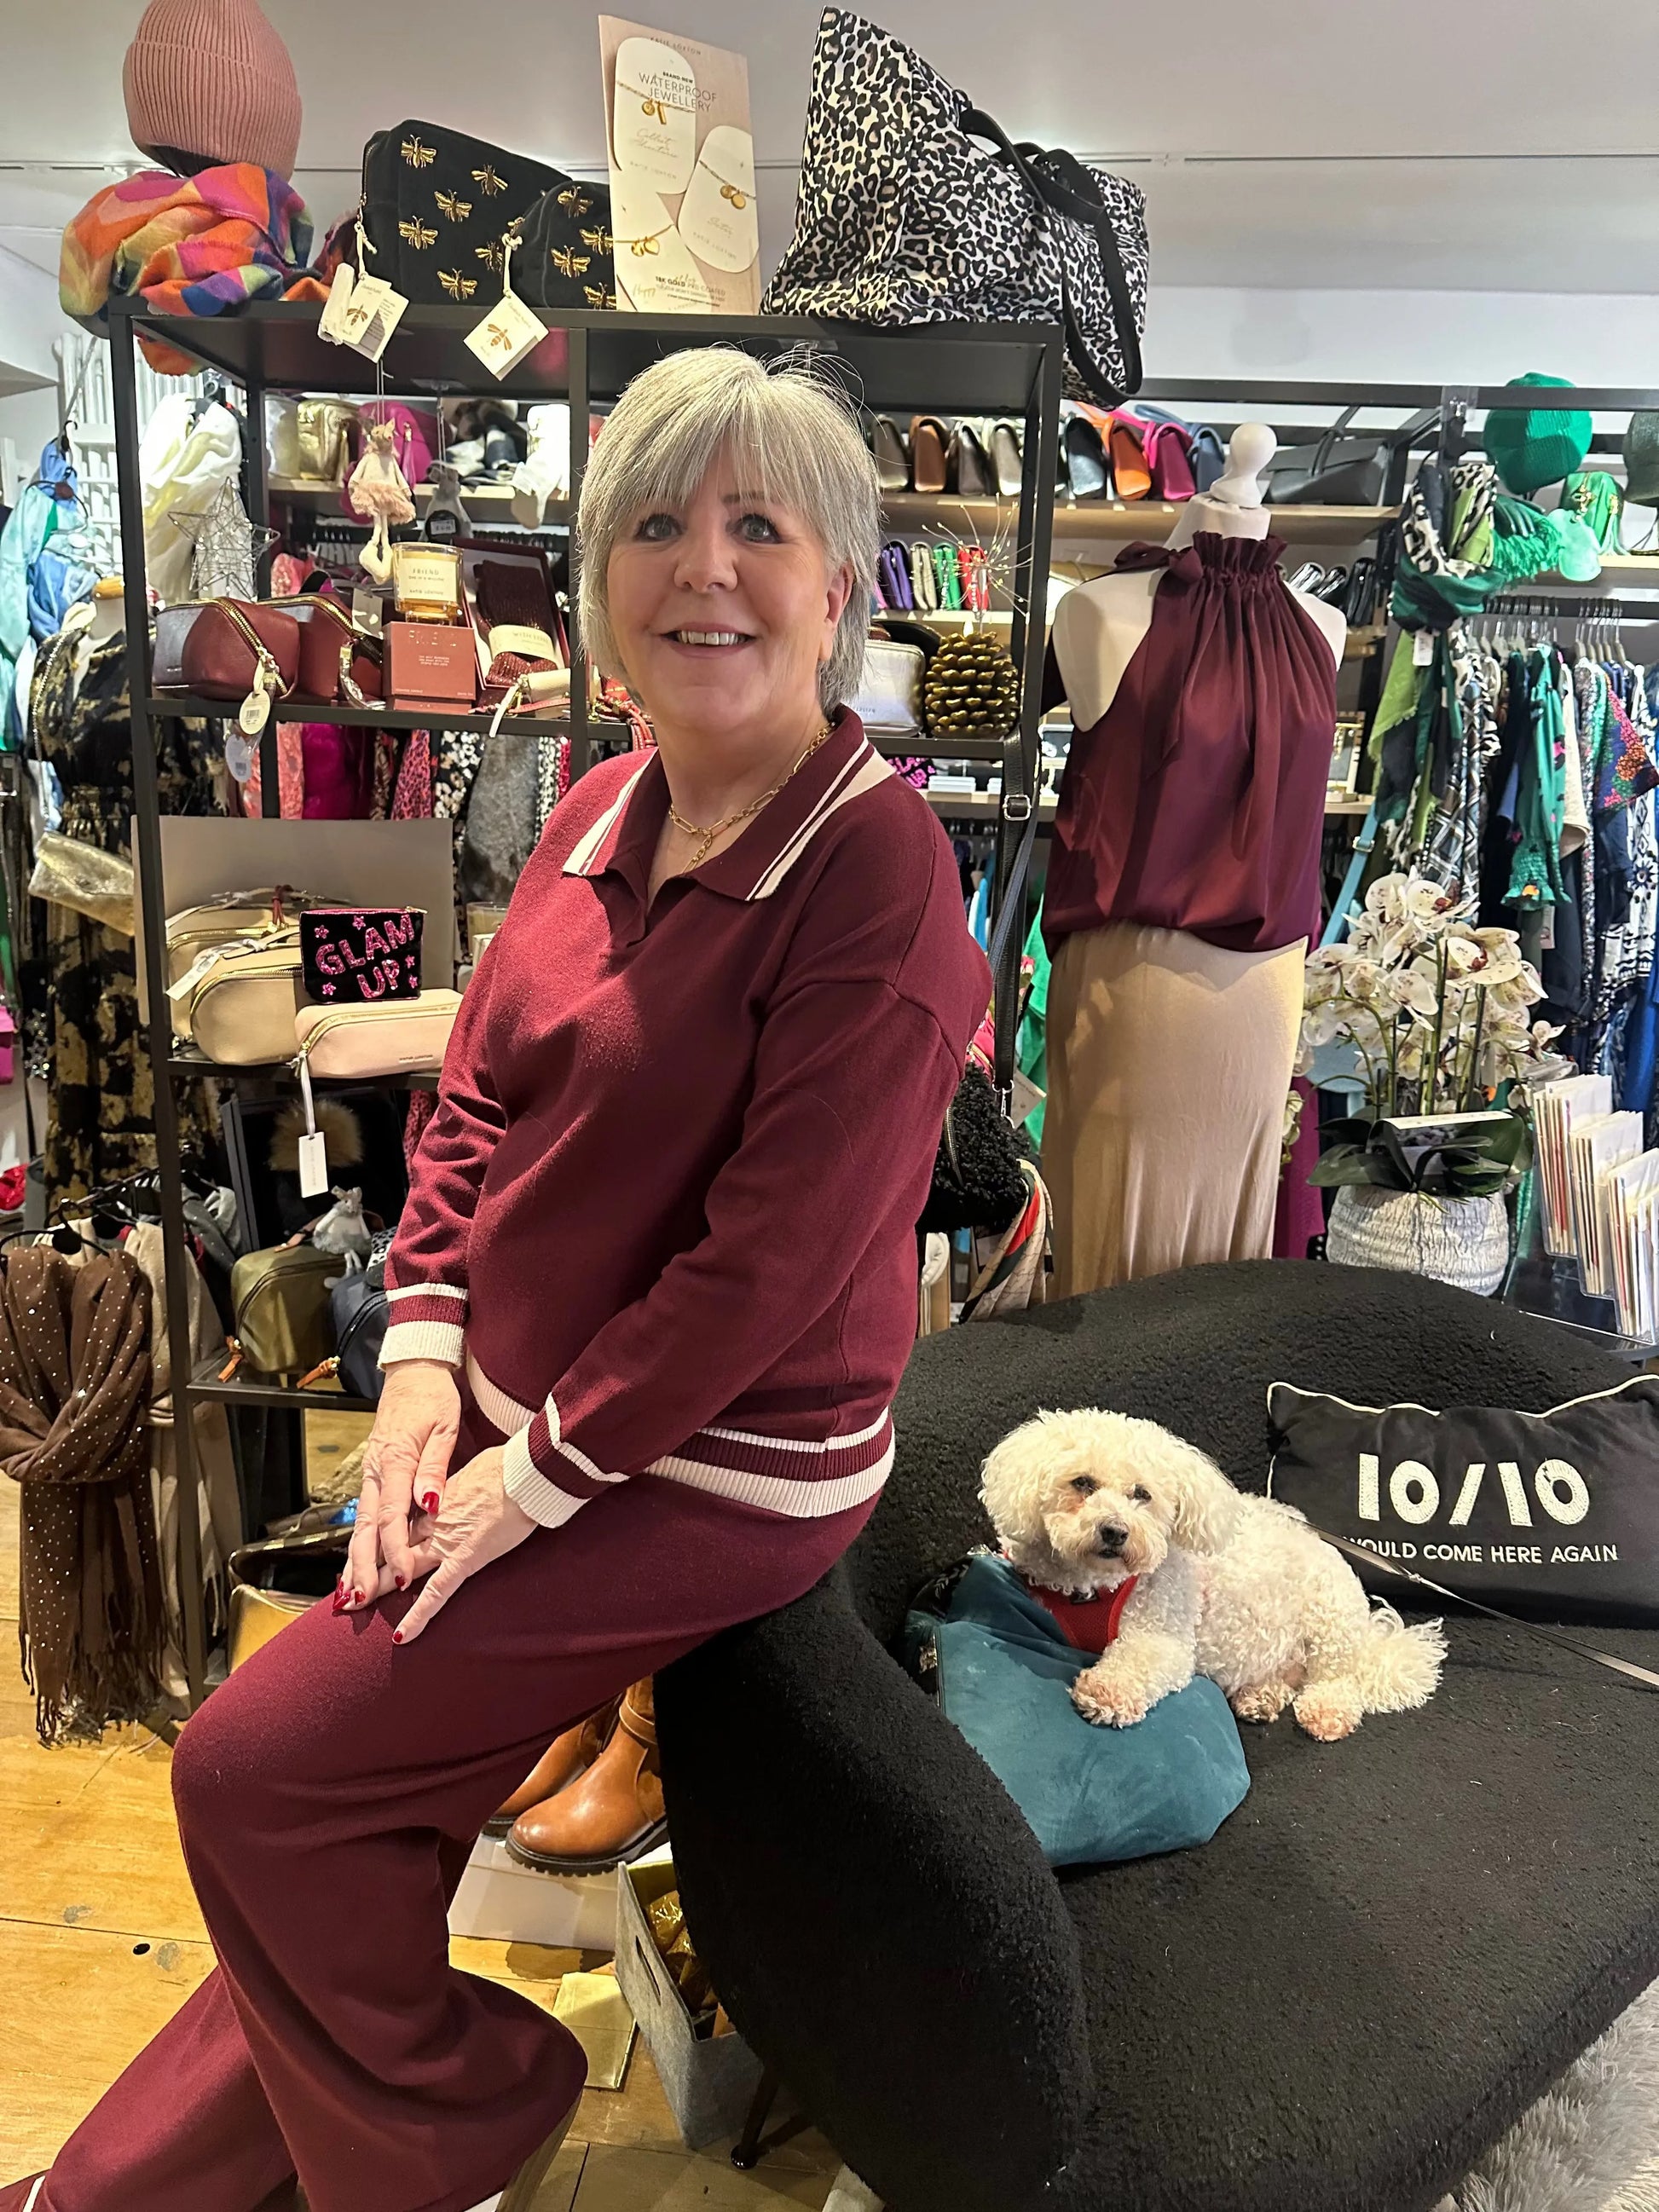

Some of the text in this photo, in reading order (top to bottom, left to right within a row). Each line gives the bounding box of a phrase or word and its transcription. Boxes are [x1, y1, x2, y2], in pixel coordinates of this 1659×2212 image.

[639, 72, 717, 102] WATERPROOF
[662, 72, 680, 80] BRAND
[648, 87, 711, 113] JEWELLERY
[668, 278, 686, 288] GOLD
[315, 914, 415, 975] GLAM
[356, 959, 400, 998] UP
[1359, 1453, 1591, 1528] 10/10
[1424, 1544, 1483, 1563] COME
[1490, 1545, 1542, 1565] HERE
[1551, 1544, 1618, 1565] AGAIN
